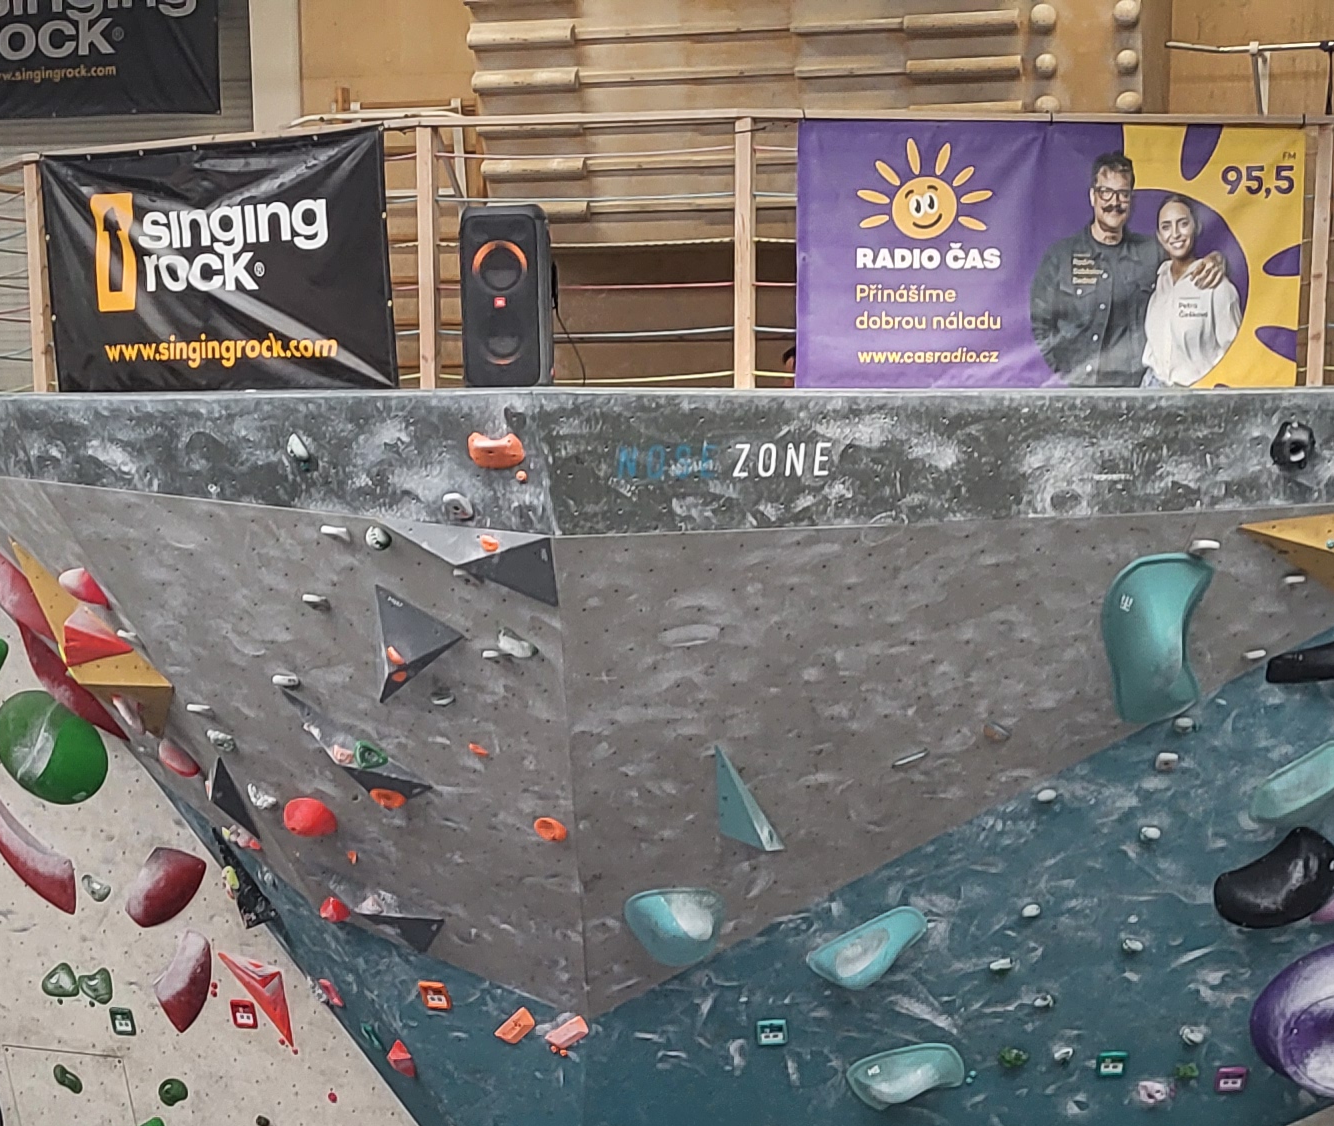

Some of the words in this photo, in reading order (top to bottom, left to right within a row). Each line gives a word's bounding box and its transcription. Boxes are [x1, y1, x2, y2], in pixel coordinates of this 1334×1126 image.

[1282, 151, 1296, 160] FM
[1221, 165, 1295, 199] 95,5
[138, 198, 329, 254] singing
[855, 247, 942, 270] RADIO
[945, 242, 1002, 270] ČAS
[855, 284, 957, 303] Přinášíme
[855, 311, 927, 330] dobrou
[932, 311, 1002, 330] náladu
[105, 332, 338, 369] www.singingrock.com
[857, 347, 1000, 364] www.casradio.cz
[732, 442, 833, 478] ZONE
